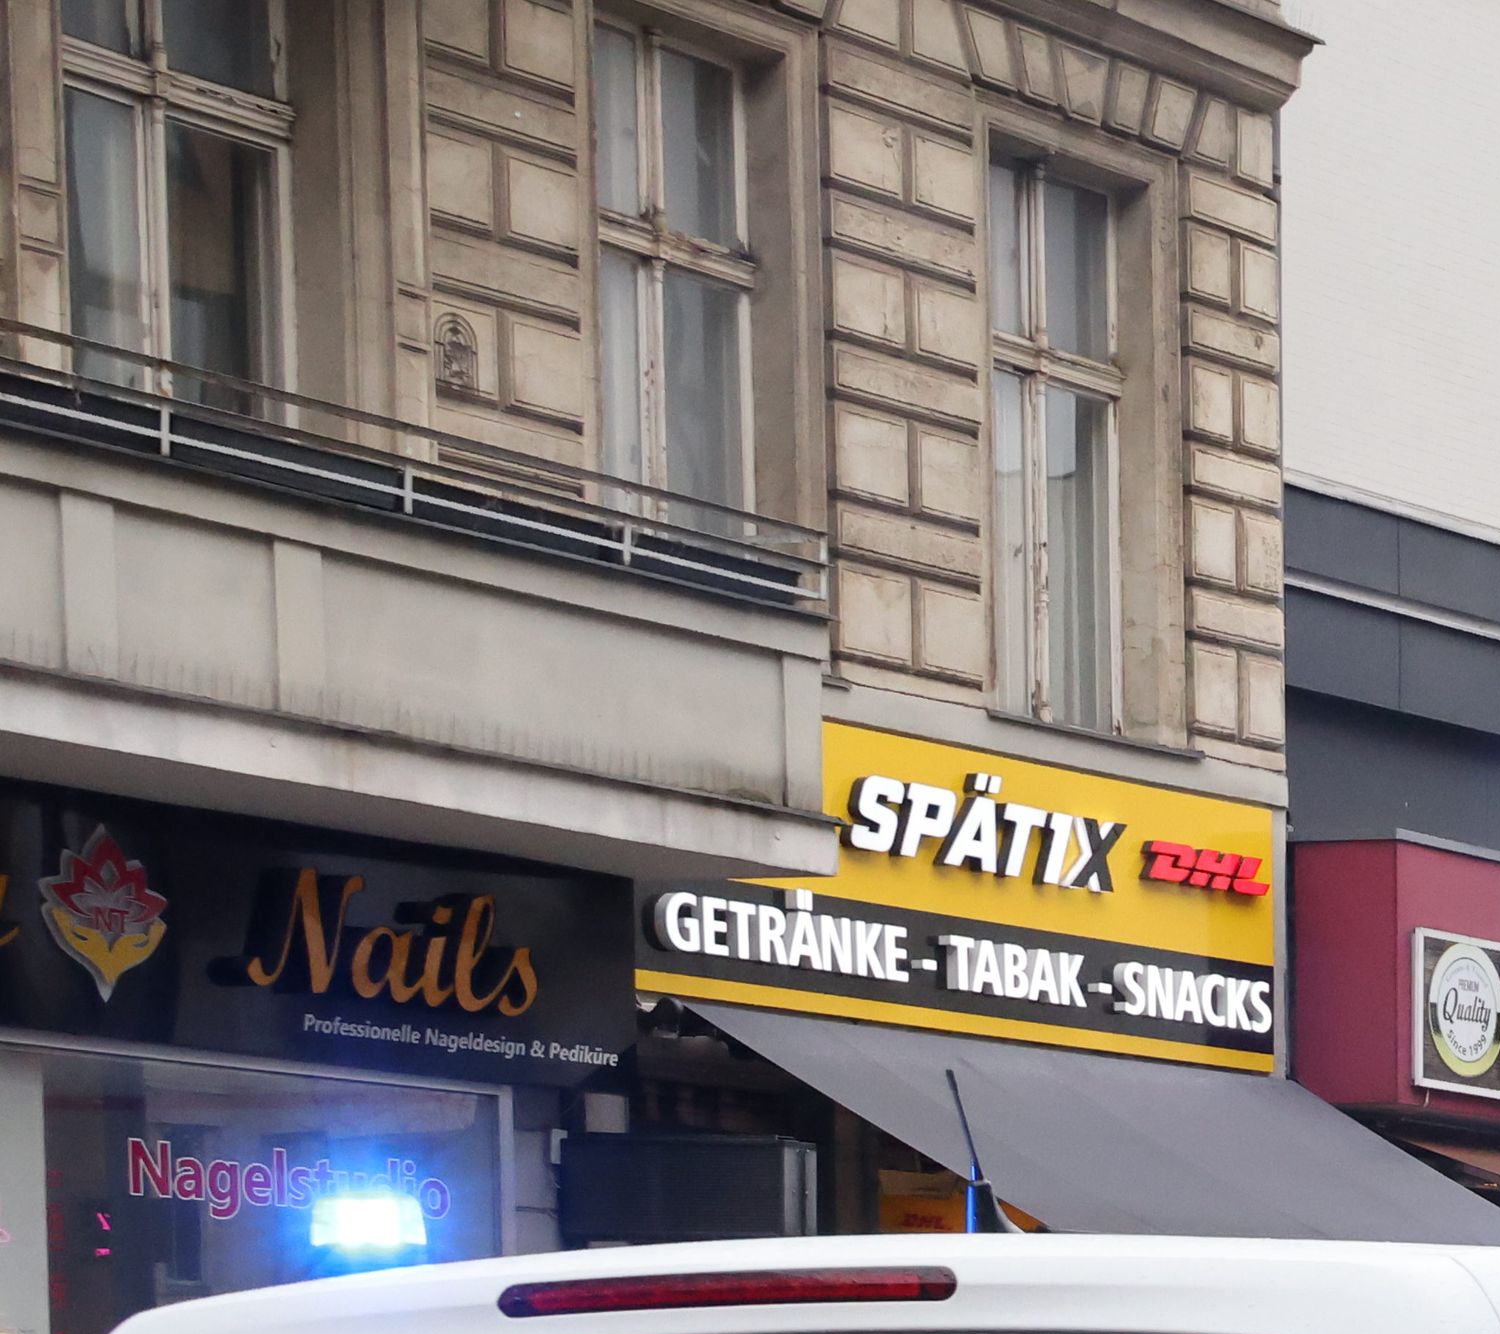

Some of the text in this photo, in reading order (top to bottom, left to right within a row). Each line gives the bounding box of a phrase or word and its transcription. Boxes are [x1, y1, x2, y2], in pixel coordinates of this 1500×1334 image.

[1143, 840, 1271, 898] DHL
[247, 866, 538, 1017] Nails
[658, 888, 911, 984] GETRÄNKE
[940, 933, 1088, 1009] TABAK
[1114, 960, 1273, 1034] SNACKS
[1443, 987, 1492, 1032] Quality
[303, 1012, 619, 1067] Professionelle Nageldesign & Pediküre
